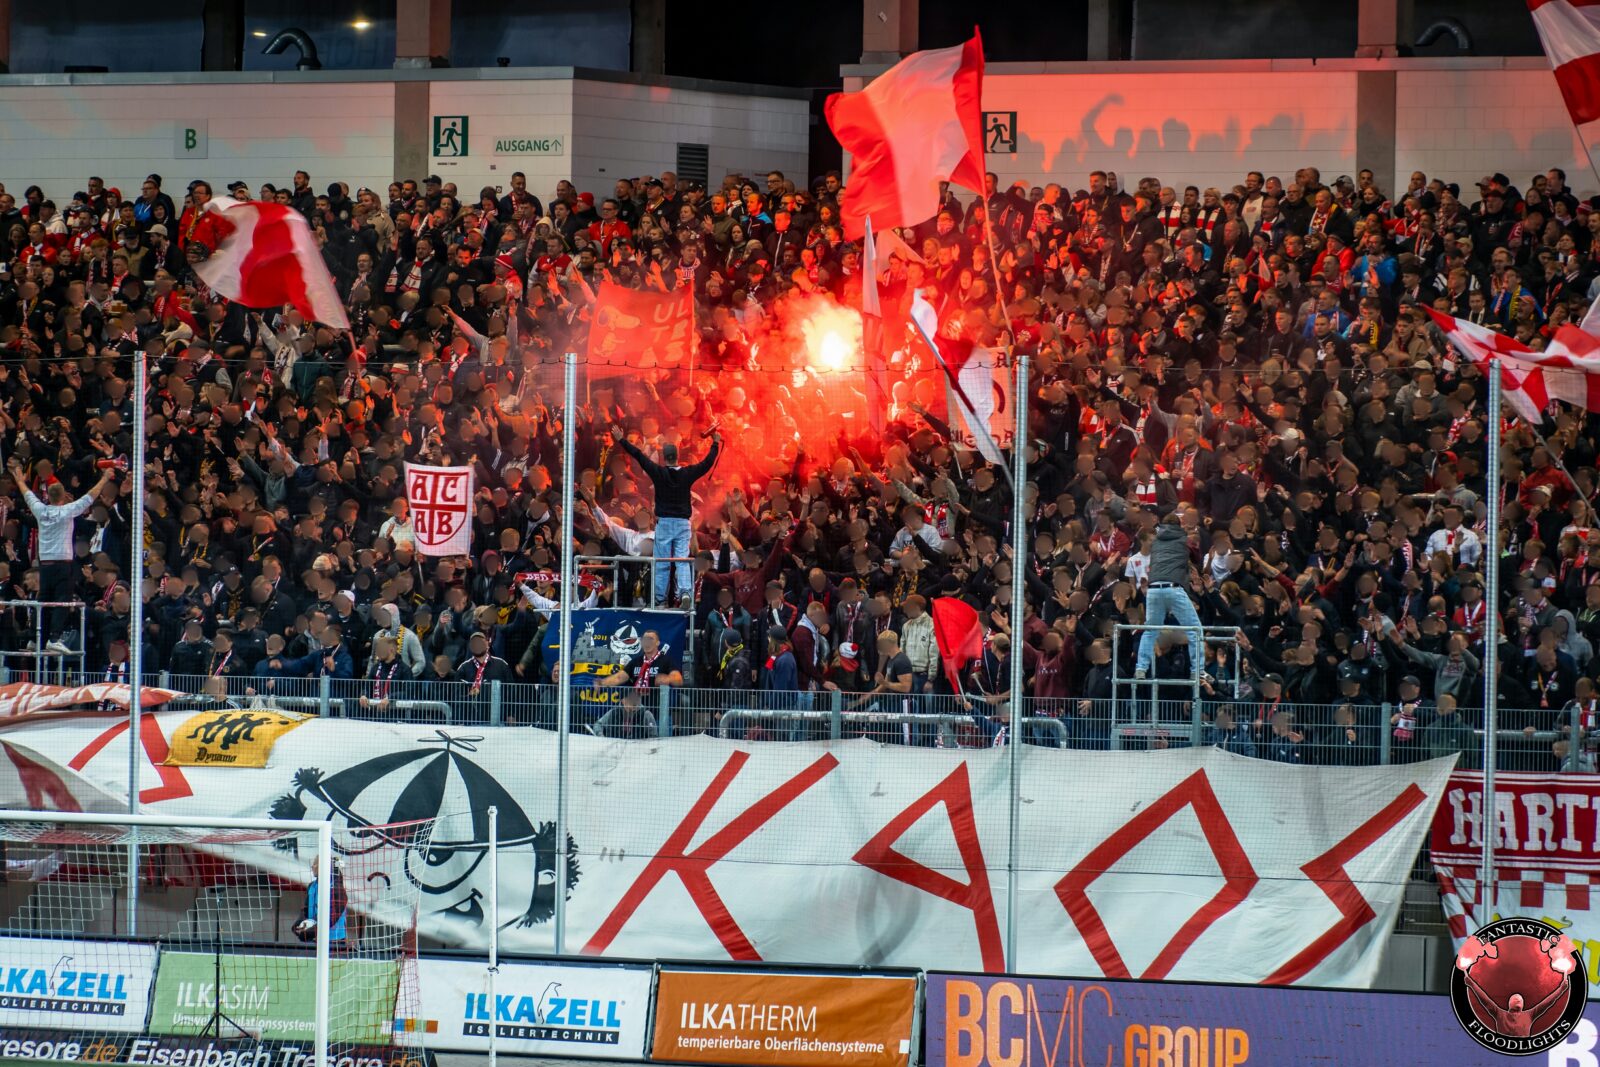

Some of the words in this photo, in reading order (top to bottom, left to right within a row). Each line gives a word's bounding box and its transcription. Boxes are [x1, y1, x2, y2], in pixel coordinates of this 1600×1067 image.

[185, 129, 197, 149] B
[496, 140, 549, 152] AUSGANG
[194, 746, 238, 763] Dynamo
[57, 970, 128, 1000] ZELL
[465, 993, 537, 1024] ILKA
[546, 998, 621, 1028] ZELL
[680, 1002, 817, 1033] ILKATHERM
[946, 979, 1113, 1067] BCMC
[468, 1025, 613, 1042] ISLIERTECHNIK
[677, 1035, 761, 1051] temperierbare
[764, 1036, 884, 1056] Oberflächensysteme
[1124, 1023, 1250, 1067] GROUP
[128, 1040, 272, 1067] Eisenbach
